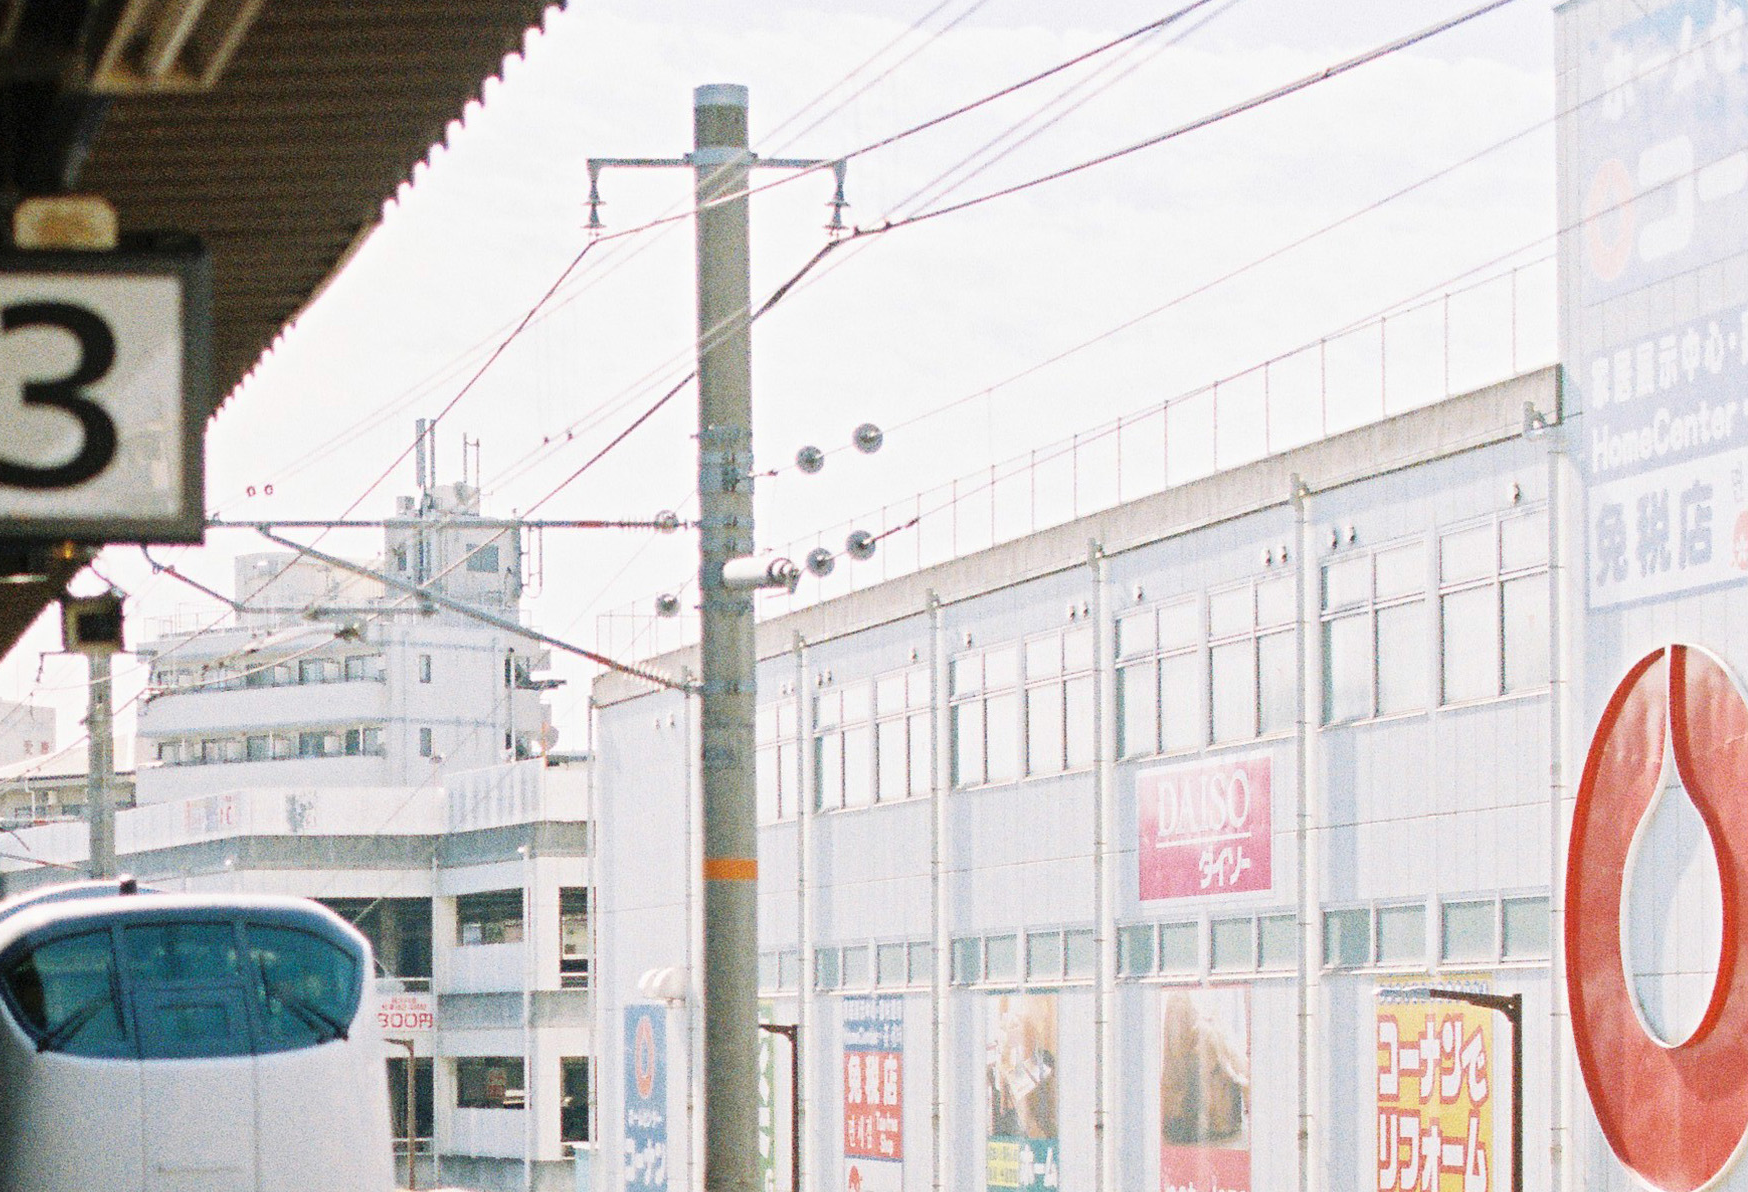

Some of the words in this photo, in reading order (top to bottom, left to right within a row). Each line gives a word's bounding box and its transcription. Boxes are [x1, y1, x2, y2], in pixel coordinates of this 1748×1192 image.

[1157, 768, 1251, 837] DAISO
[1377, 1013, 1490, 1107] コーナンで
